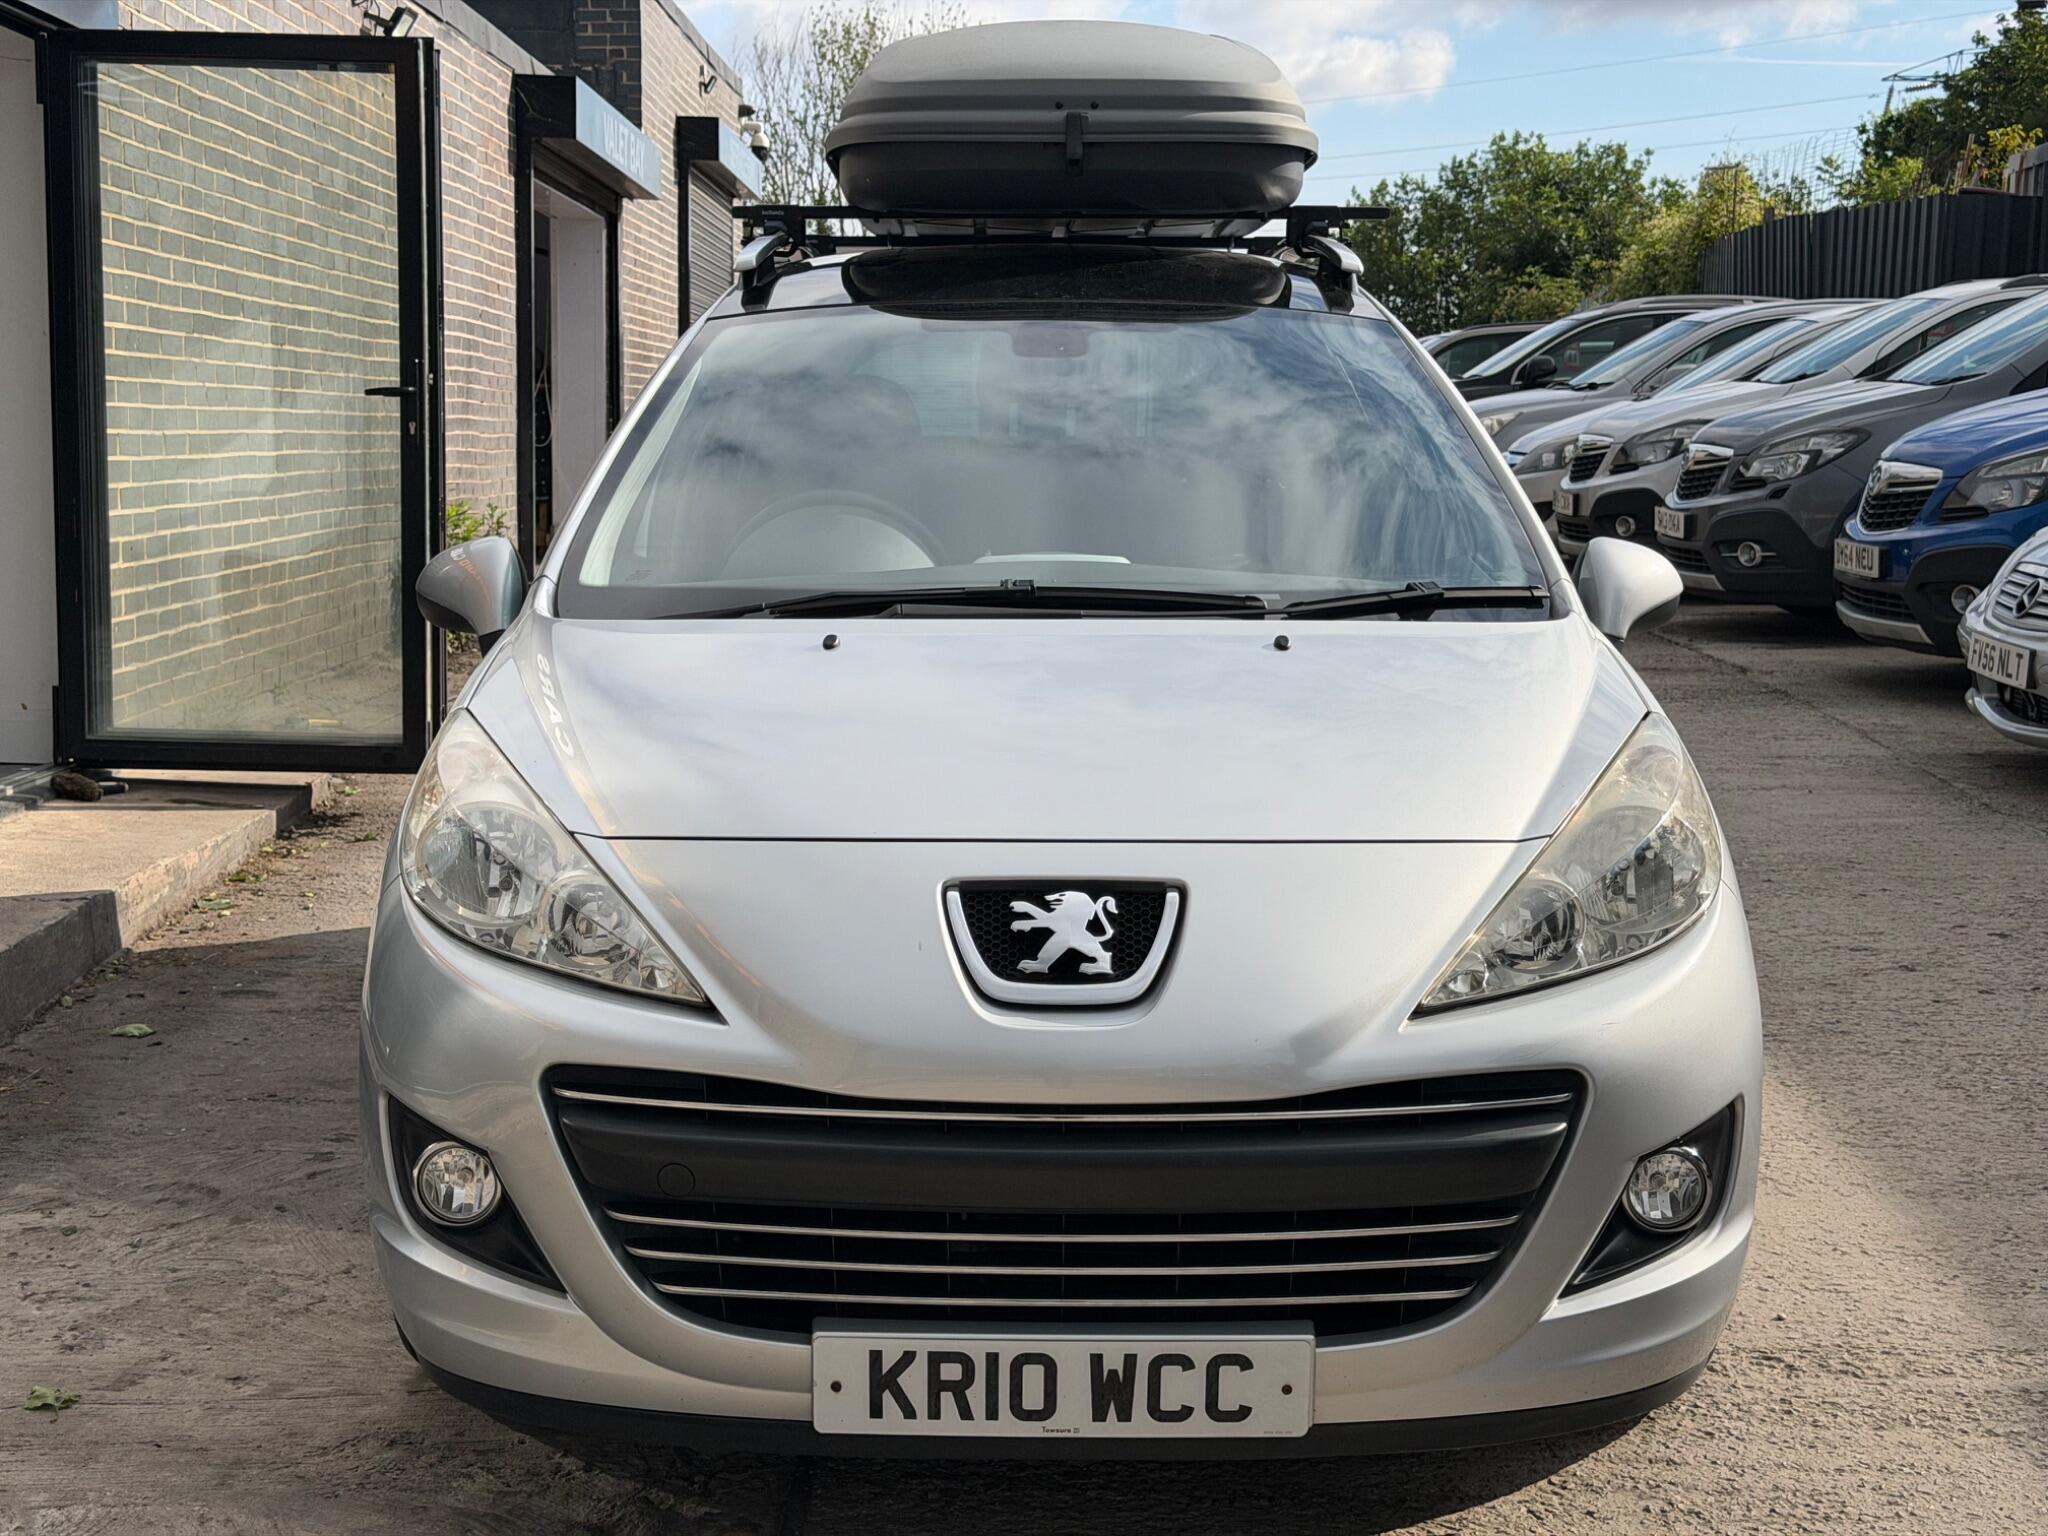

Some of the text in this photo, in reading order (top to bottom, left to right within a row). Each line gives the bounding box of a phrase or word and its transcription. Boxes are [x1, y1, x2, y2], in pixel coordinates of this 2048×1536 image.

[603, 111, 646, 180] VALET BAY
[1855, 545, 1874, 571] NEU
[1970, 638, 2023, 681] FV56 NLT
[868, 1349, 1254, 1423] KR10 WCC
